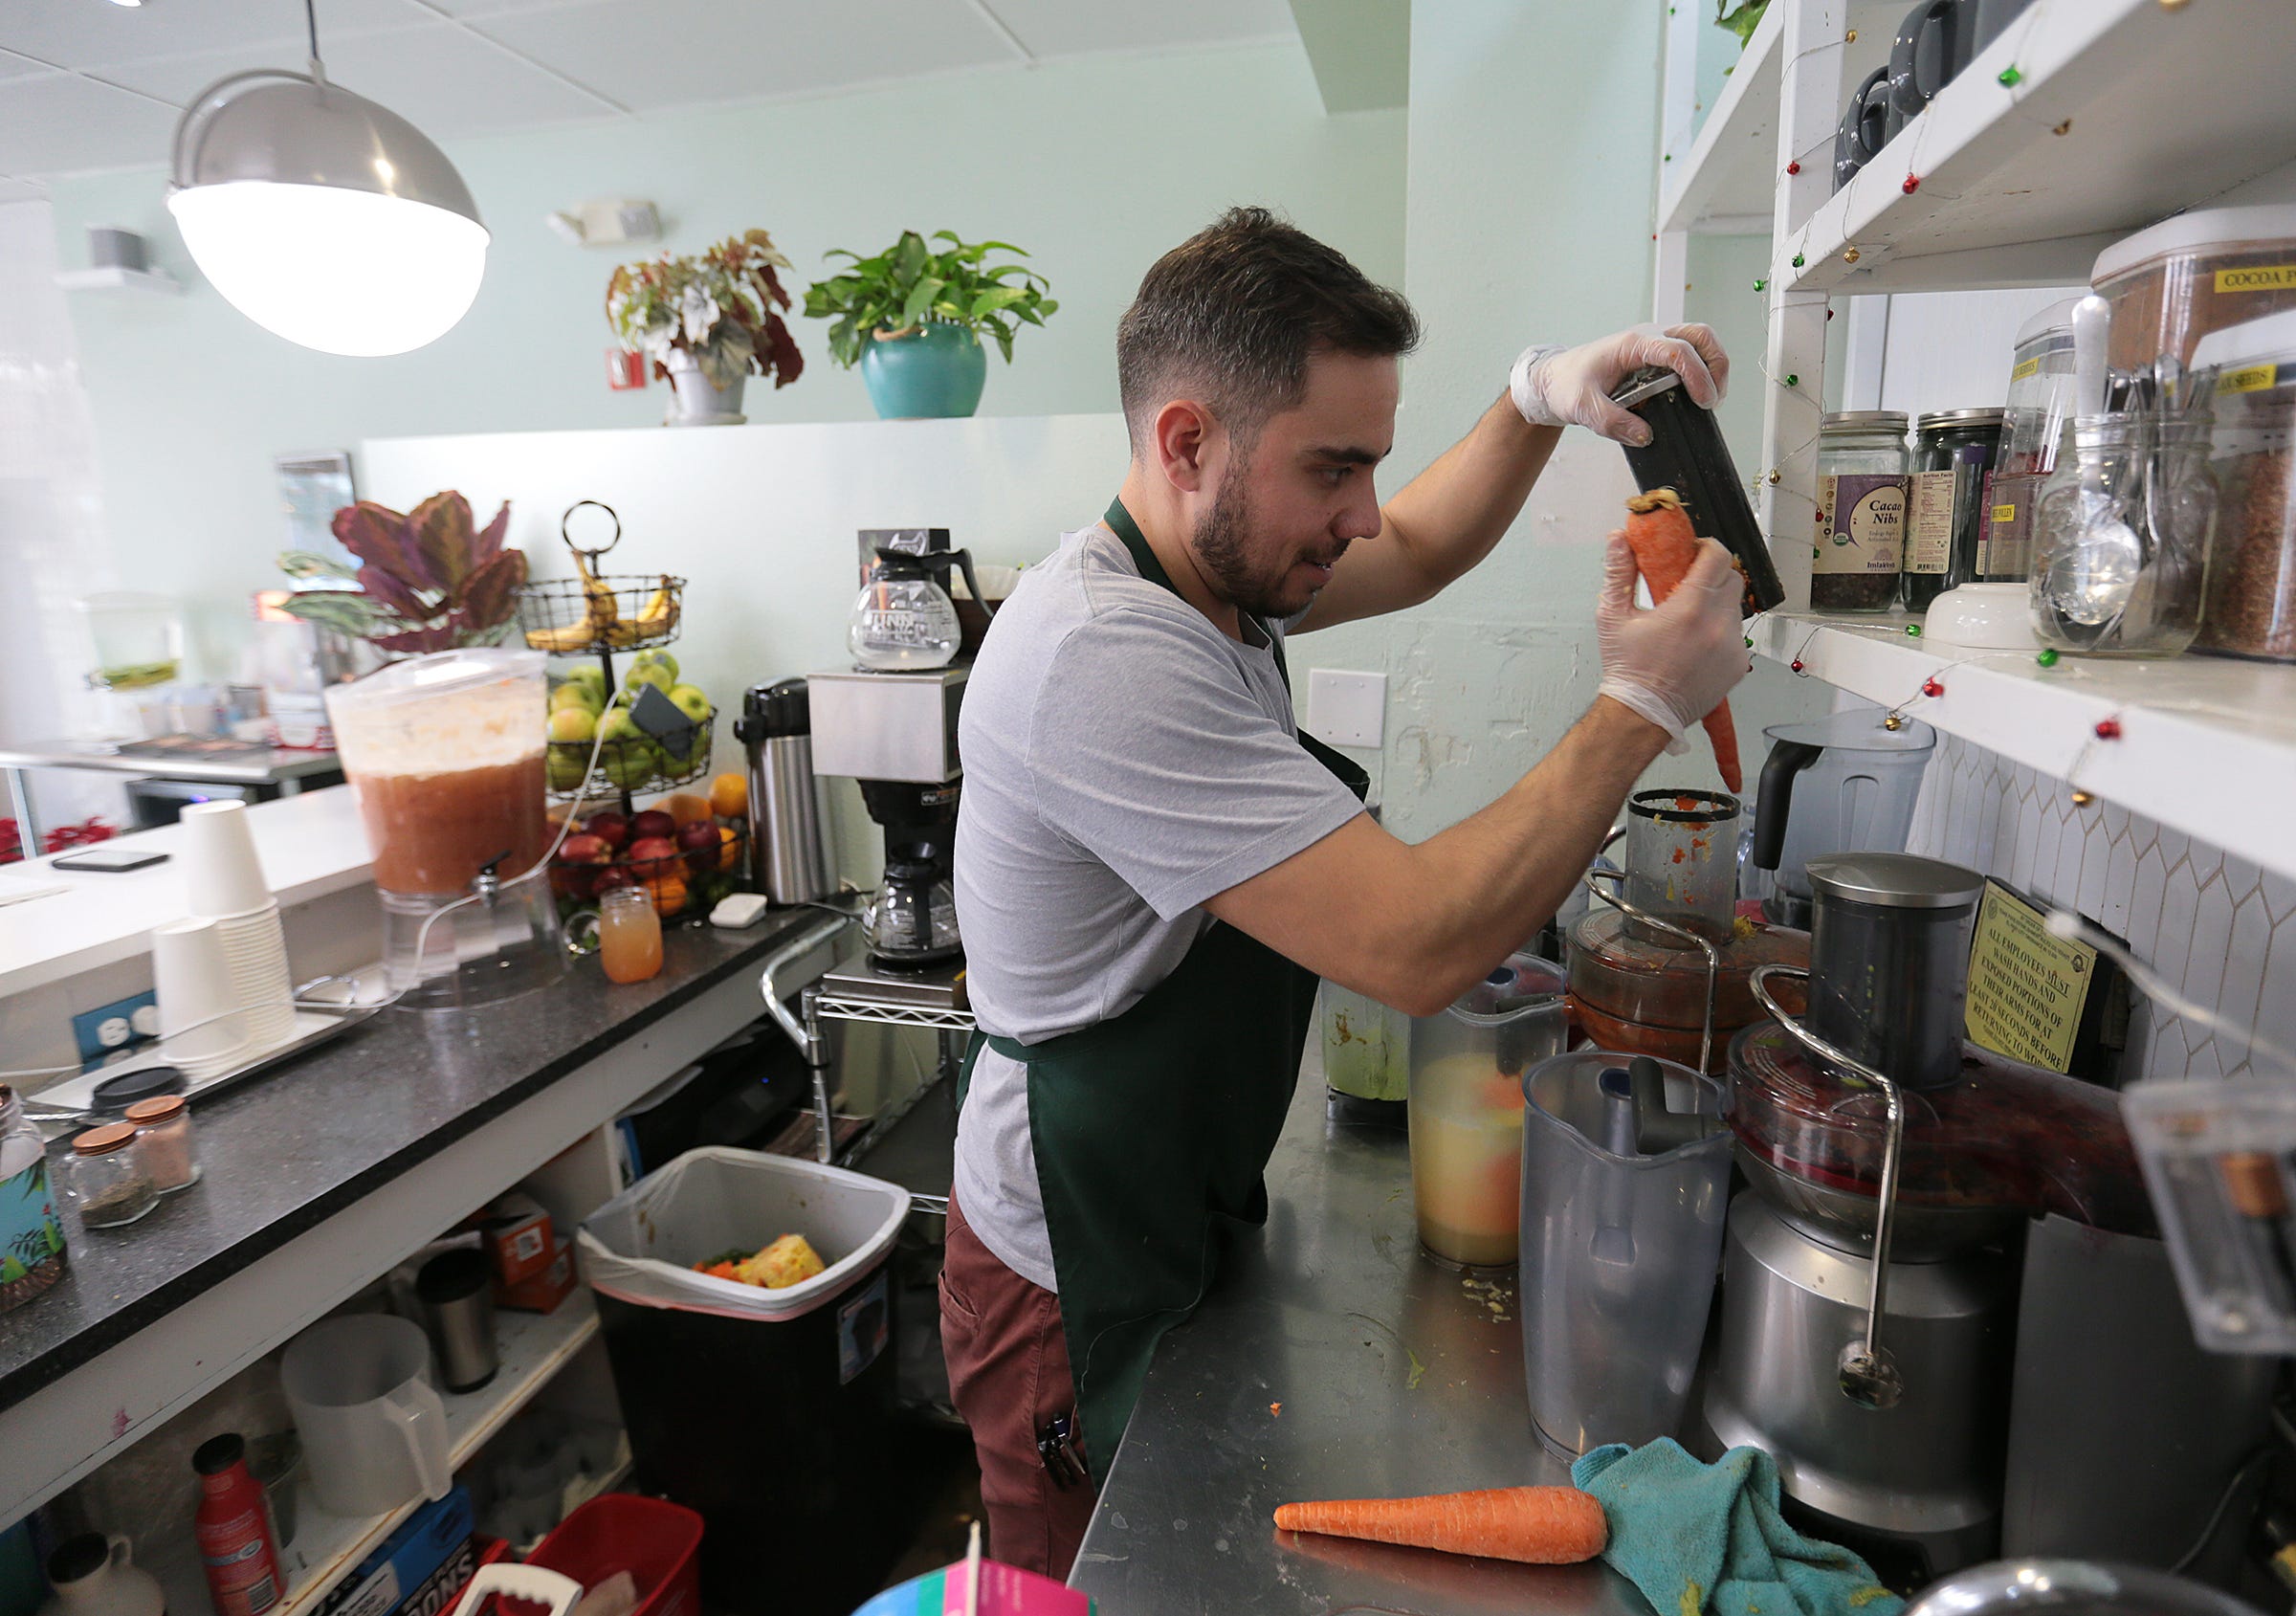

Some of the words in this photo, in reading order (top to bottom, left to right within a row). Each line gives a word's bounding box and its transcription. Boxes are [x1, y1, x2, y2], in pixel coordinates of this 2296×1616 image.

[2224, 271, 2281, 287] COCOA
[1869, 499, 1902, 512] Cacao
[1872, 513, 1898, 524] Nibs
[1981, 956, 2013, 988] EXPOSED
[2012, 983, 2050, 1019] PORTIONS
[2050, 1012, 2064, 1028] OF
[1988, 928, 2001, 944] ALL
[2001, 936, 2046, 977] EMPLOYEES
[2046, 969, 2071, 995] MUST
[1993, 947, 2014, 971] WASH
[2013, 967, 2039, 991] HANDS
[2038, 985, 2056, 1004] AND
[1969, 981, 1990, 1006] LEAST
[1990, 1000, 1998, 1012] 20
[1998, 1007, 2029, 1042] SECONDS
[2030, 1035, 2064, 1069] BEFORE
[1974, 1002, 2012, 1045] RETURNING
[2012, 1038, 2024, 1054] TO
[2023, 1048, 2045, 1068] WOR
[1983, 974, 2004, 999] THEIR
[2004, 994, 2024, 1017] ARMS
[2024, 1009, 2042, 1030] FOR
[2042, 1026, 2054, 1040] AT
